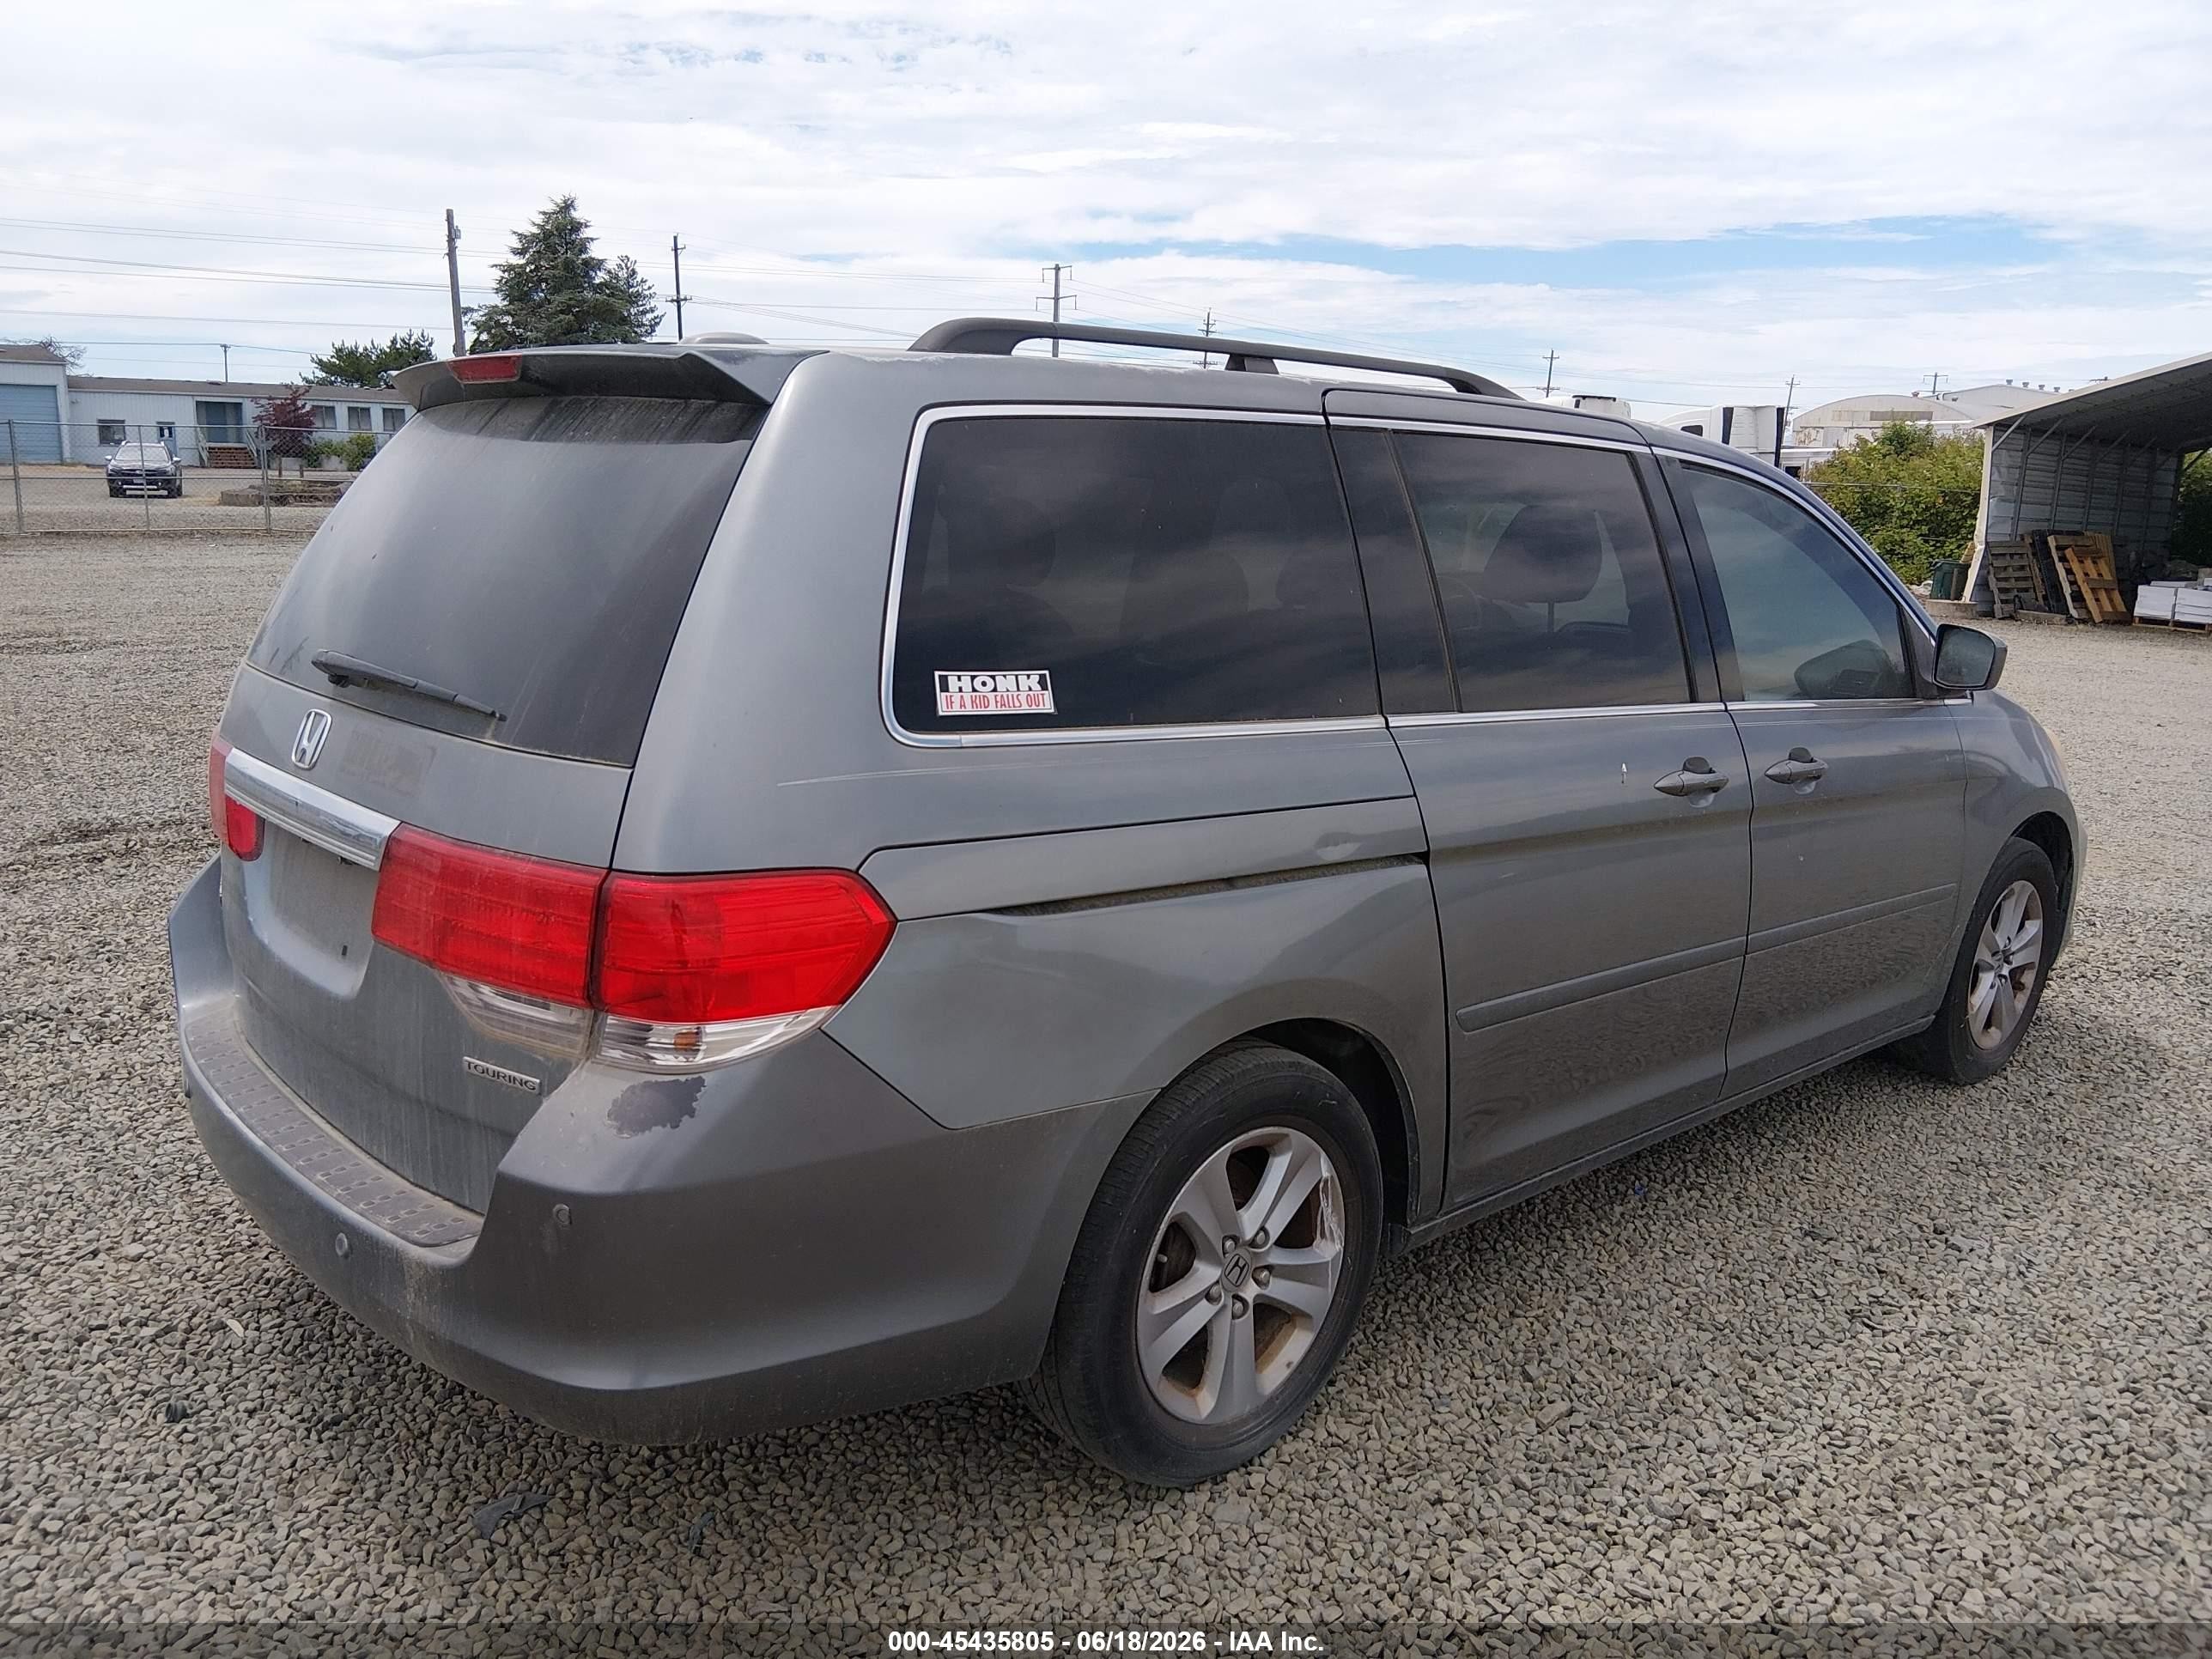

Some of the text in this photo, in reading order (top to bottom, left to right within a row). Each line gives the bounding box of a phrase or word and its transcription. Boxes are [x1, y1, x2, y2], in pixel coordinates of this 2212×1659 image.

[947, 675, 1042, 693] HONK
[945, 693, 1046, 710] IF A KID FALLS OUT
[465, 1060, 537, 1091] TOURING
